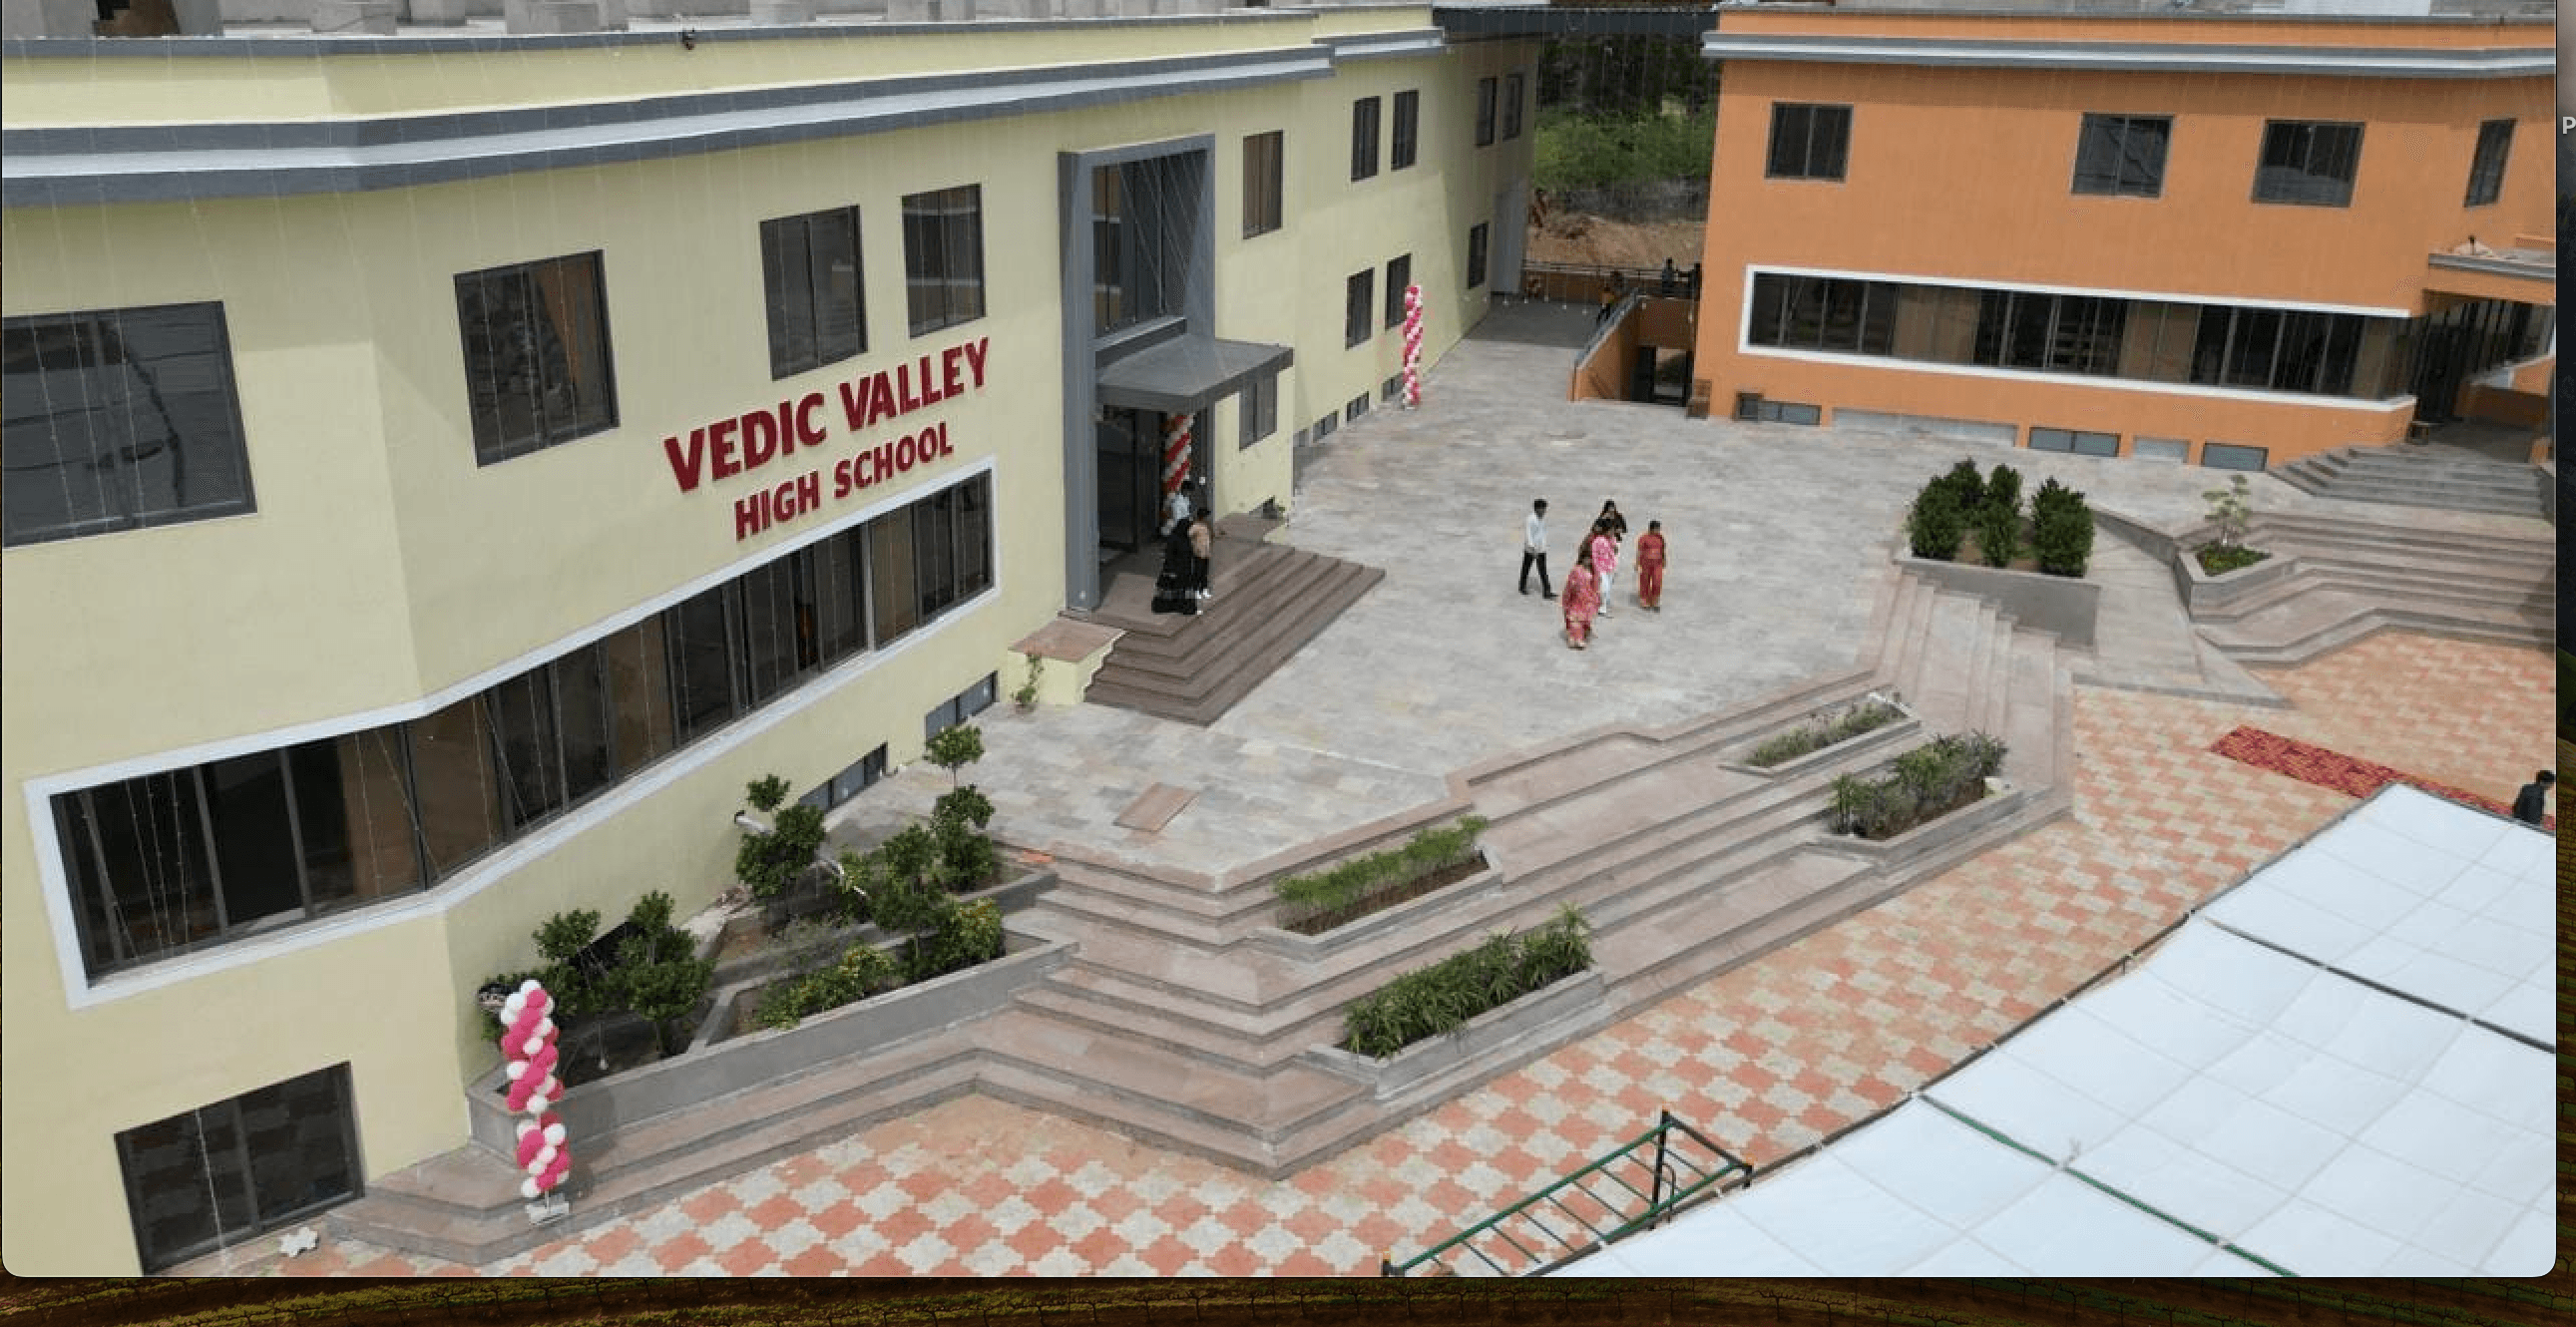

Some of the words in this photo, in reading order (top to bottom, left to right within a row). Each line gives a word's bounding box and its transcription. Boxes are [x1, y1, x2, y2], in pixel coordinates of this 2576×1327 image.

[663, 392, 827, 493] VEDIC
[838, 336, 990, 432] VALLEY
[734, 470, 821, 542] HIGH
[833, 421, 954, 499] SCHOOL
